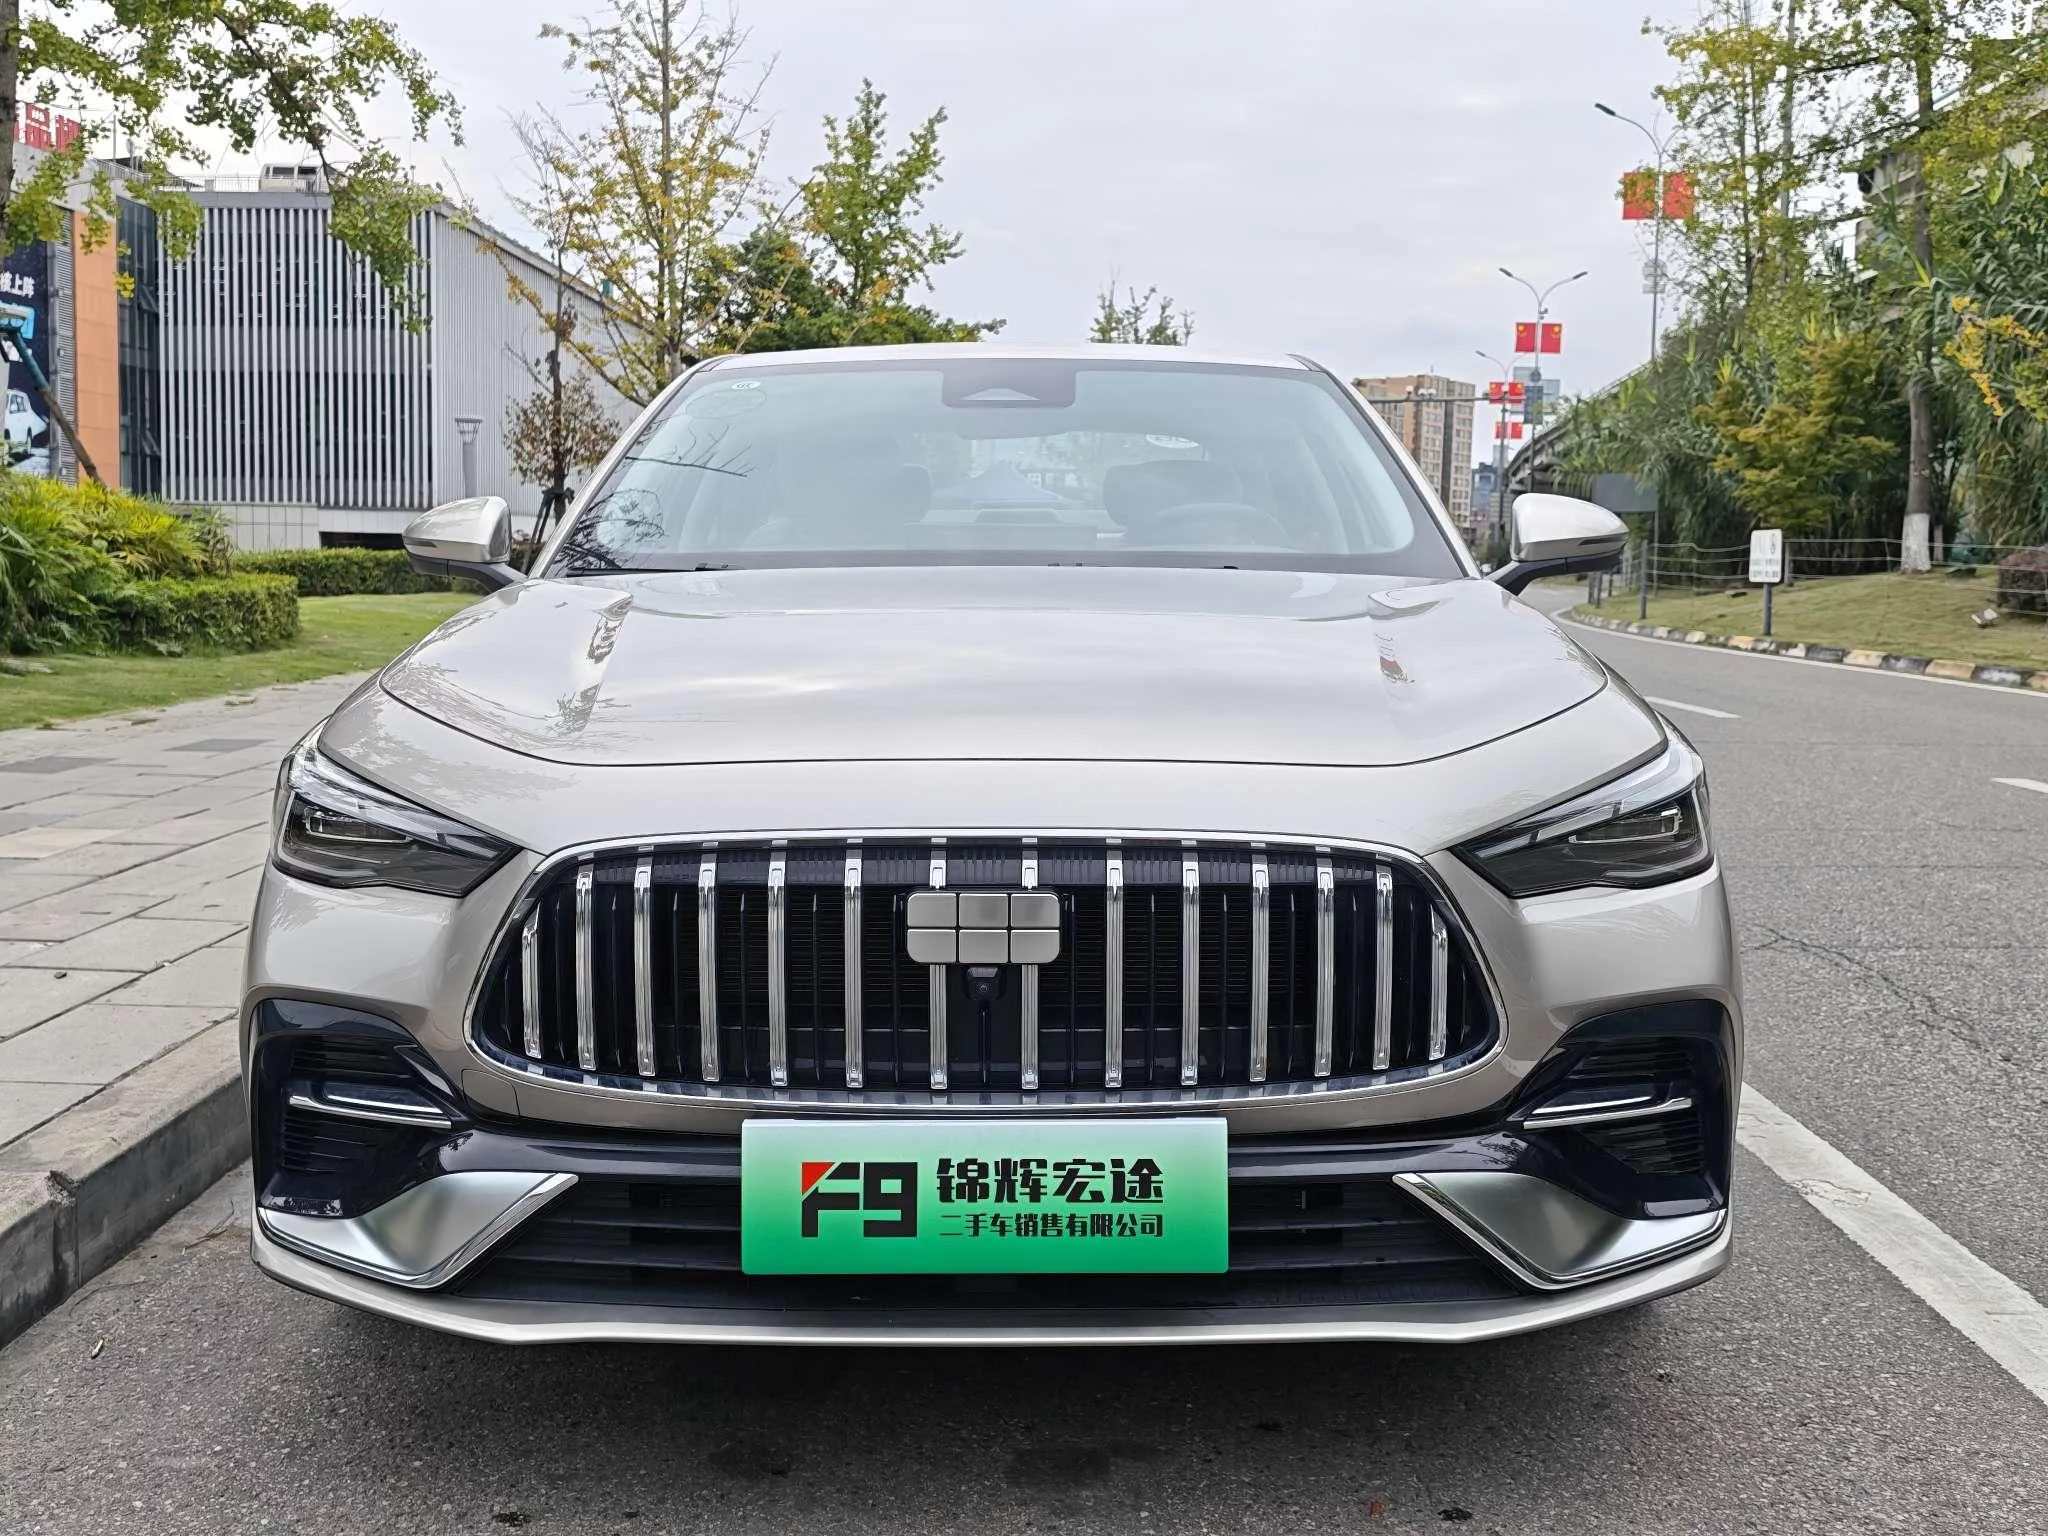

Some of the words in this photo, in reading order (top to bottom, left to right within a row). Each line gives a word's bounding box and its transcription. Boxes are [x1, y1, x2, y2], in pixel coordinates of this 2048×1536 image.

[936, 1158, 1164, 1204] 锦辉宏途
[939, 1213, 1164, 1238] 二手车销售有限公司
